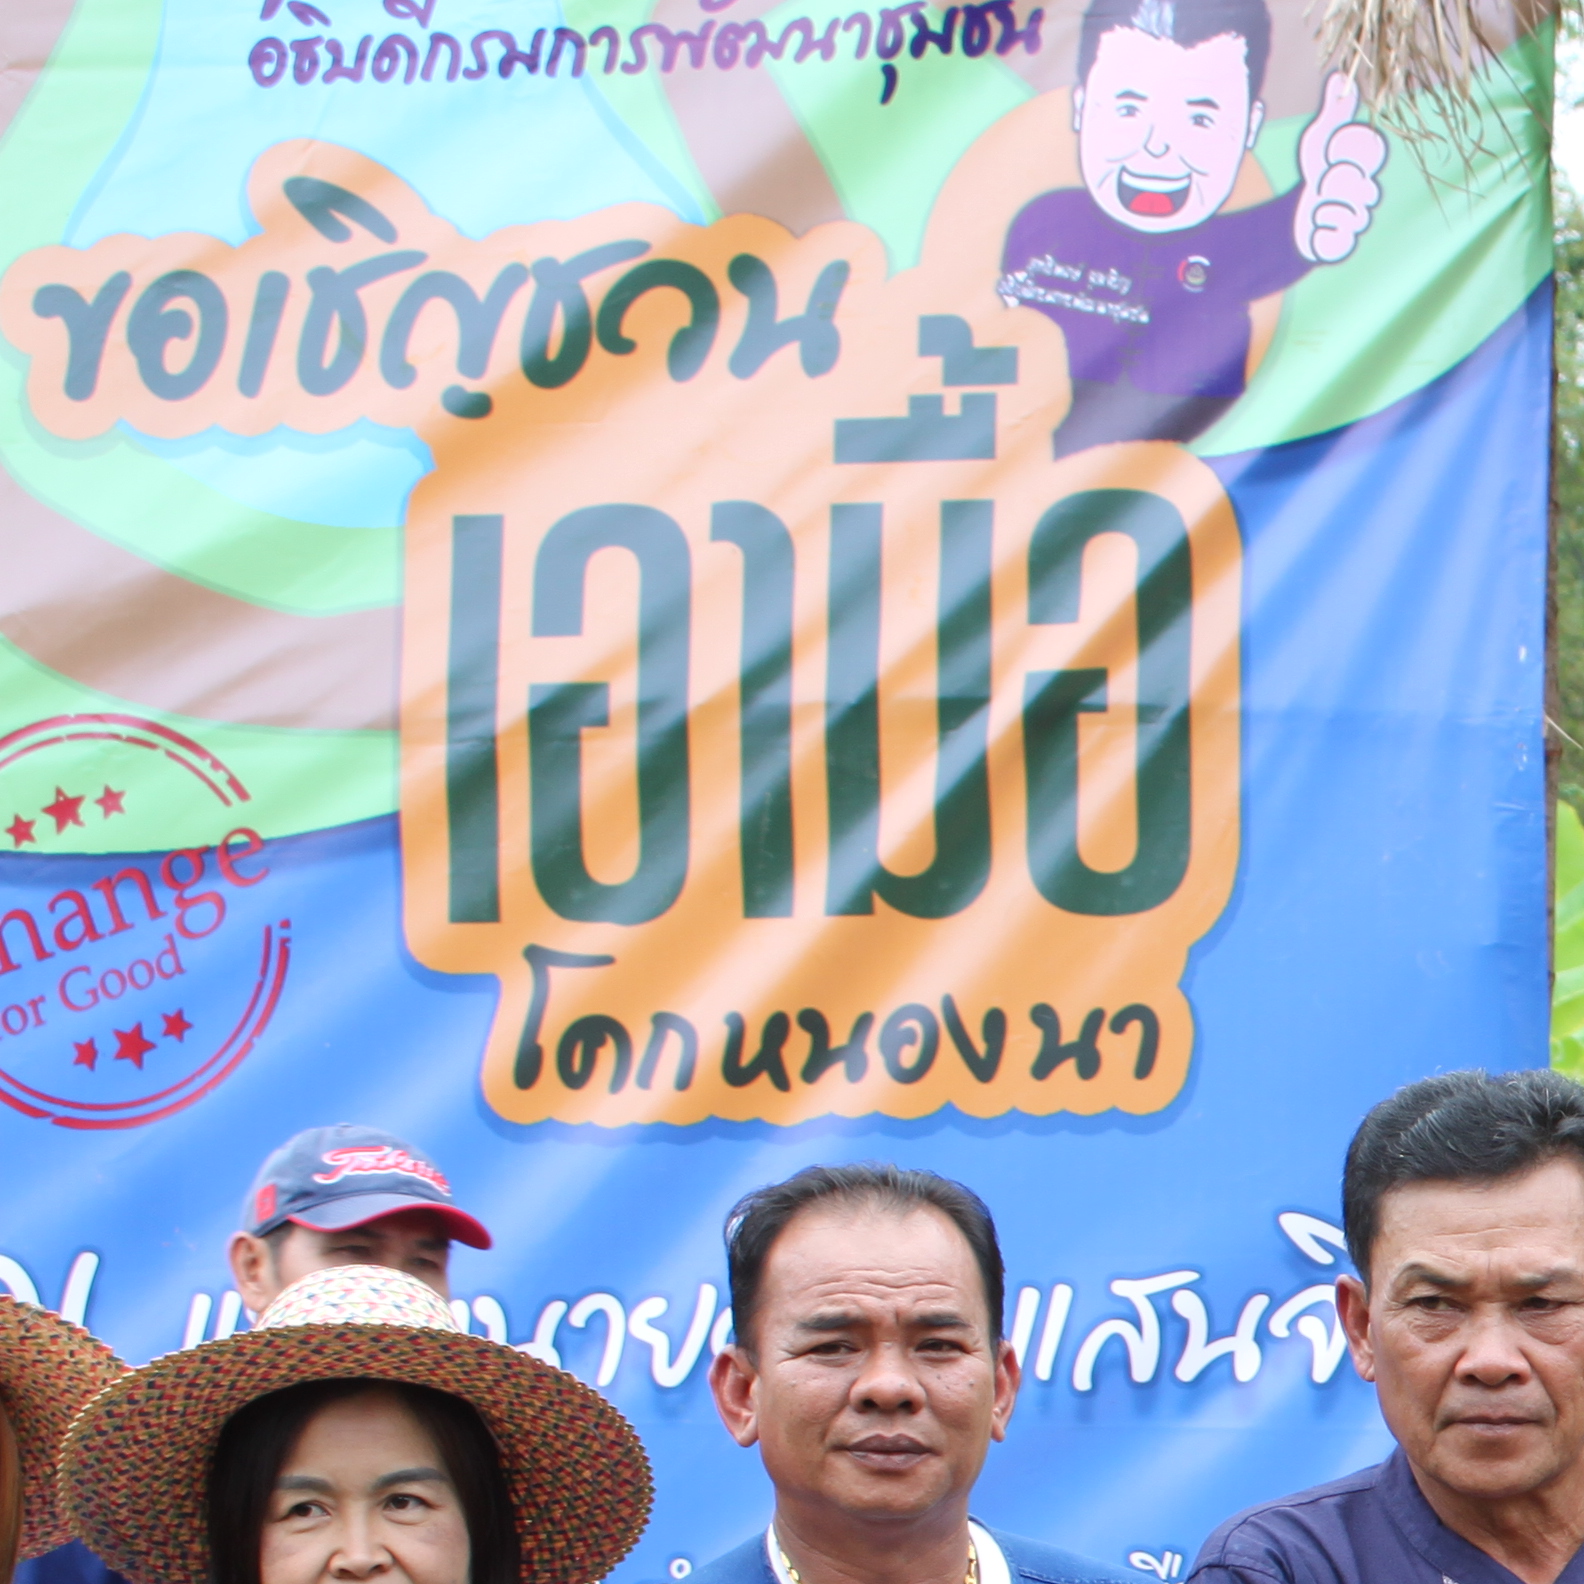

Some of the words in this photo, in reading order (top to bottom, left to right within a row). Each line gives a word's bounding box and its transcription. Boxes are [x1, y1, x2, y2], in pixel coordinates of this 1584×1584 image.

[33, 176, 851, 419] ขอเชิญชวน
[447, 314, 1193, 926] เอามื้อ
[0, 995, 46, 1040] or
[58, 934, 186, 1012] Good
